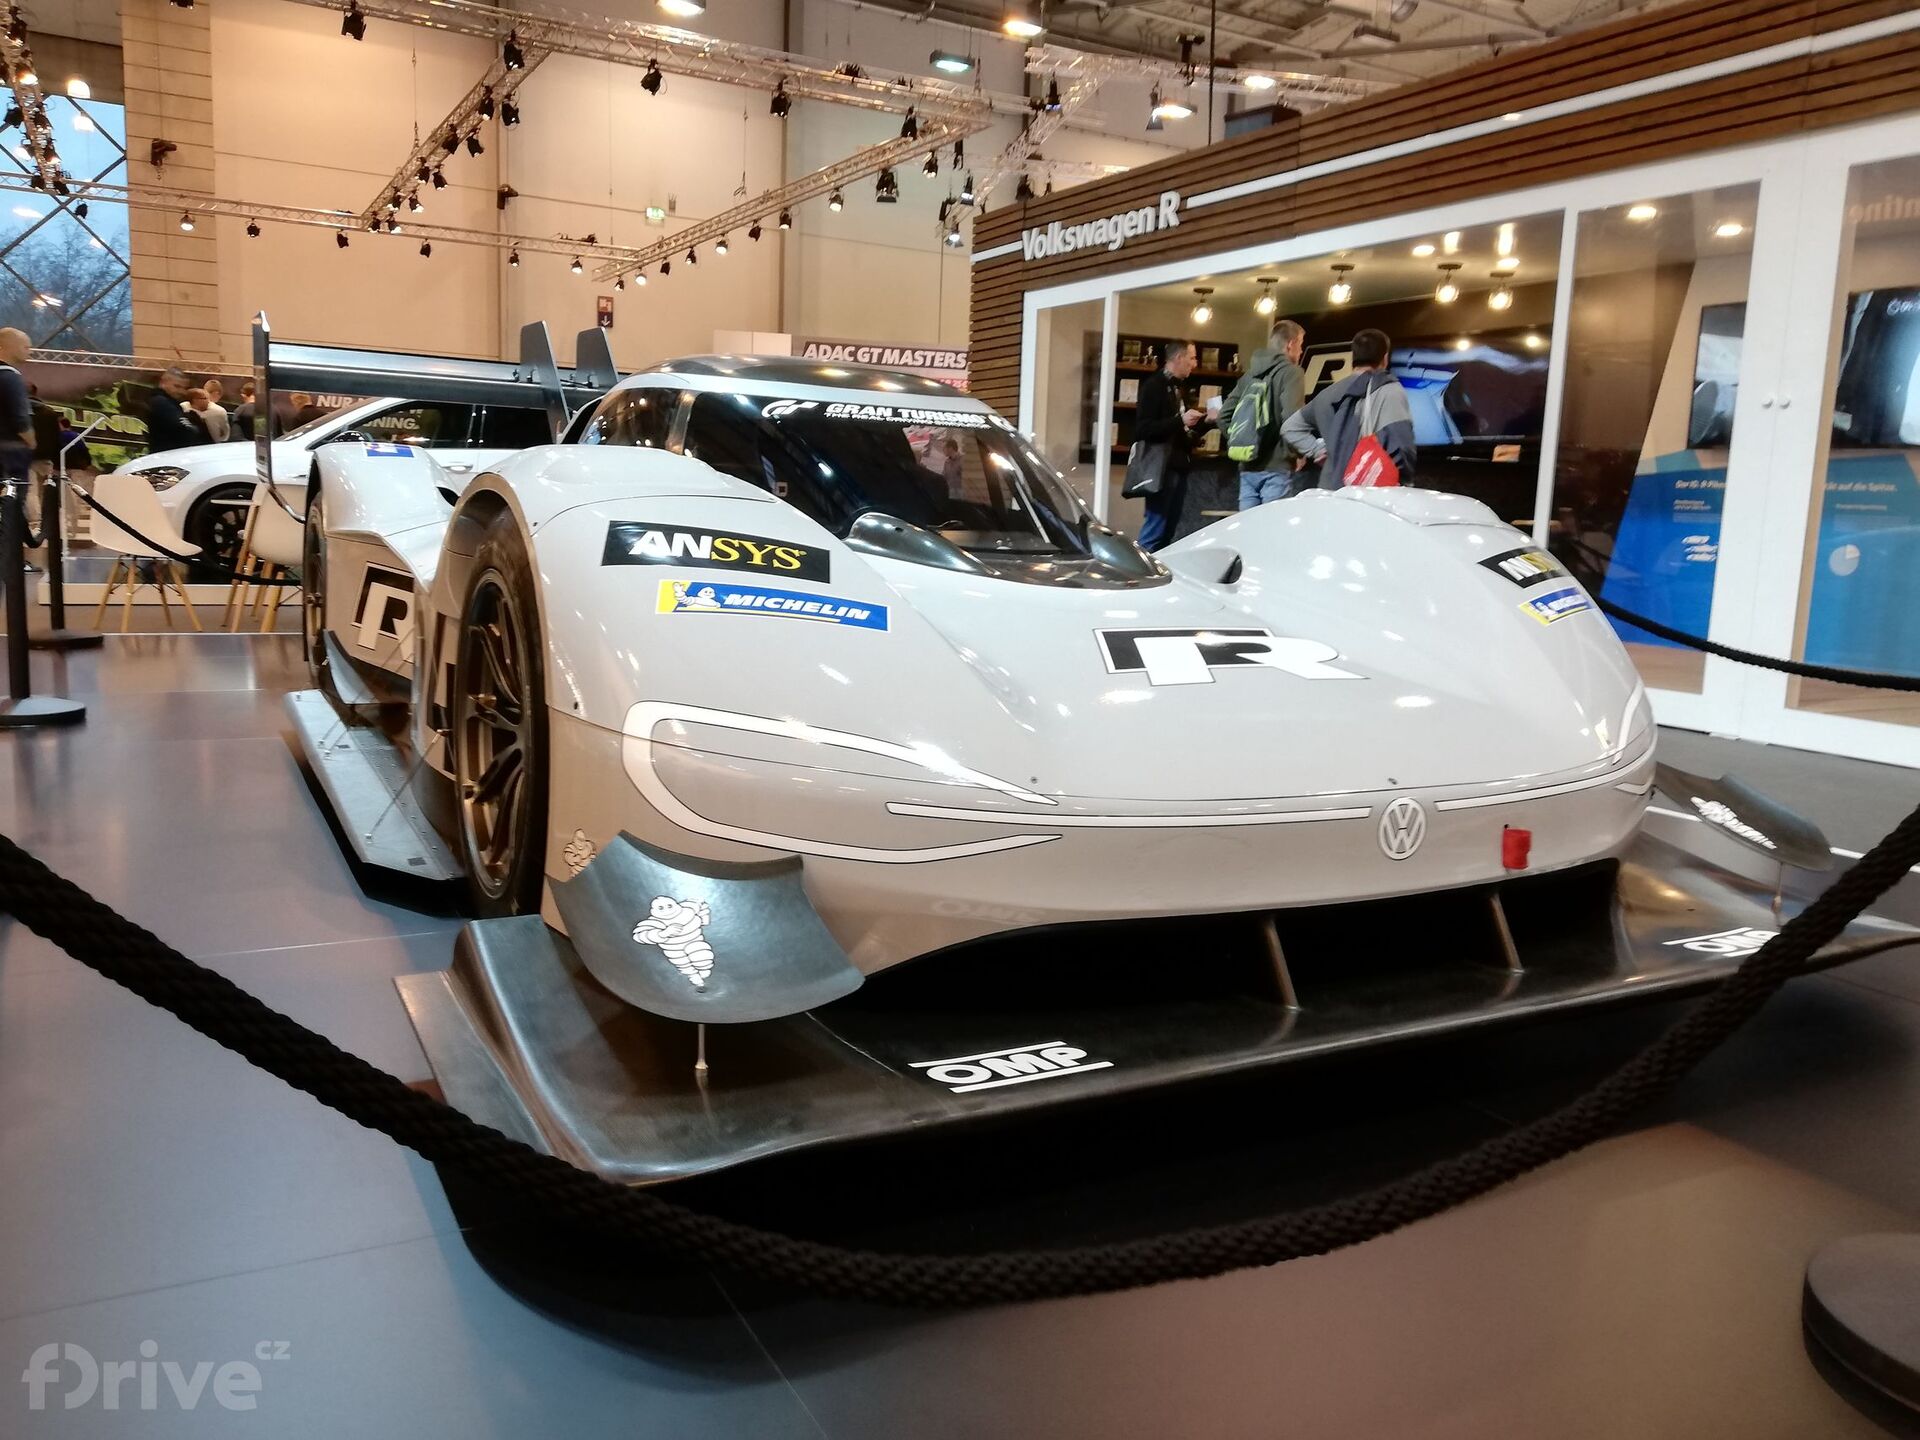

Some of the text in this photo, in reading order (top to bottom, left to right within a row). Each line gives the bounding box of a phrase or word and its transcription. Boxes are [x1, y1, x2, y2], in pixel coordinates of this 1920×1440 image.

[1022, 191, 1180, 261] Volkswagen R
[803, 343, 968, 369] ADAC GT MASTERS
[825, 403, 893, 418] GRAN
[629, 530, 803, 570] ANSYS
[724, 593, 871, 621] MICHELIN
[926, 1047, 1088, 1084] OMP
